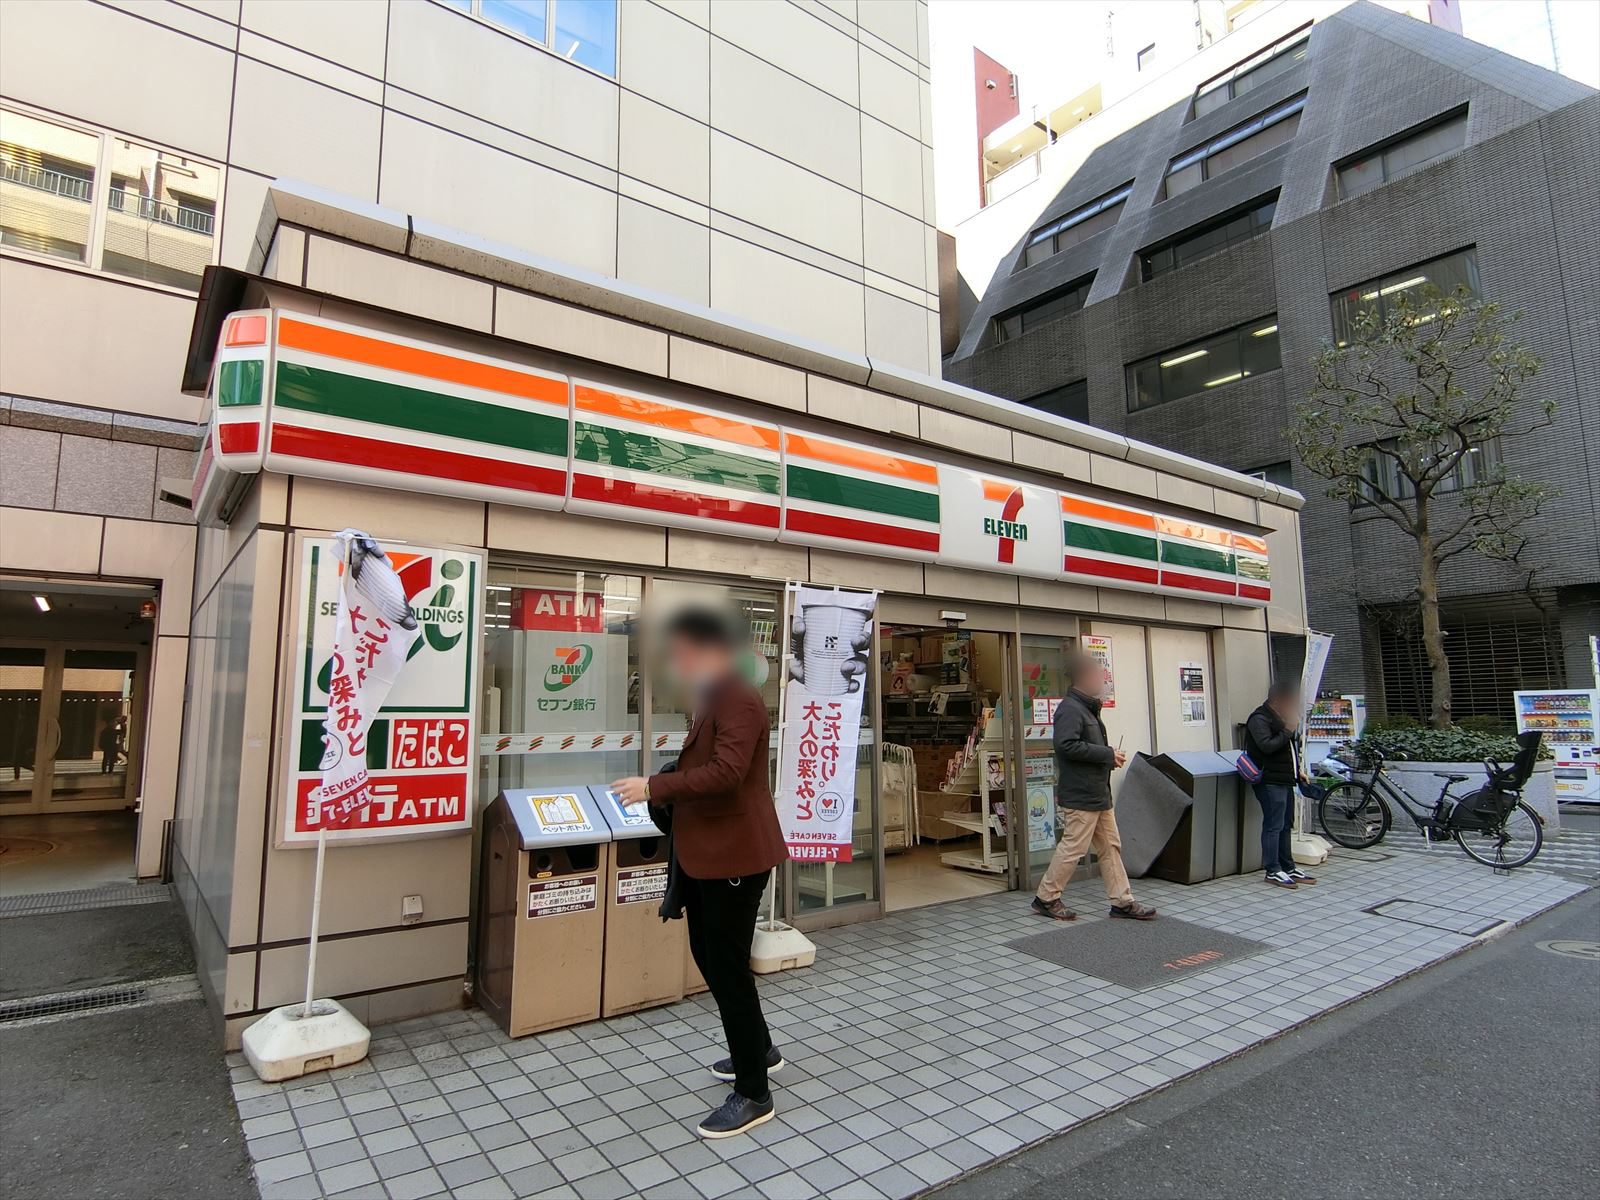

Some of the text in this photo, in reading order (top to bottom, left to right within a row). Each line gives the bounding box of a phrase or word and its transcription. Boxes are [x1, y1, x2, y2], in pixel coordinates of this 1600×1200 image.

[534, 593, 596, 618] ATM
[551, 664, 583, 675] BANK
[537, 698, 596, 711] セブン銀行
[395, 719, 466, 768] たばこ
[323, 778, 357, 797] SEVEN
[542, 824, 591, 833] ペットボトル
